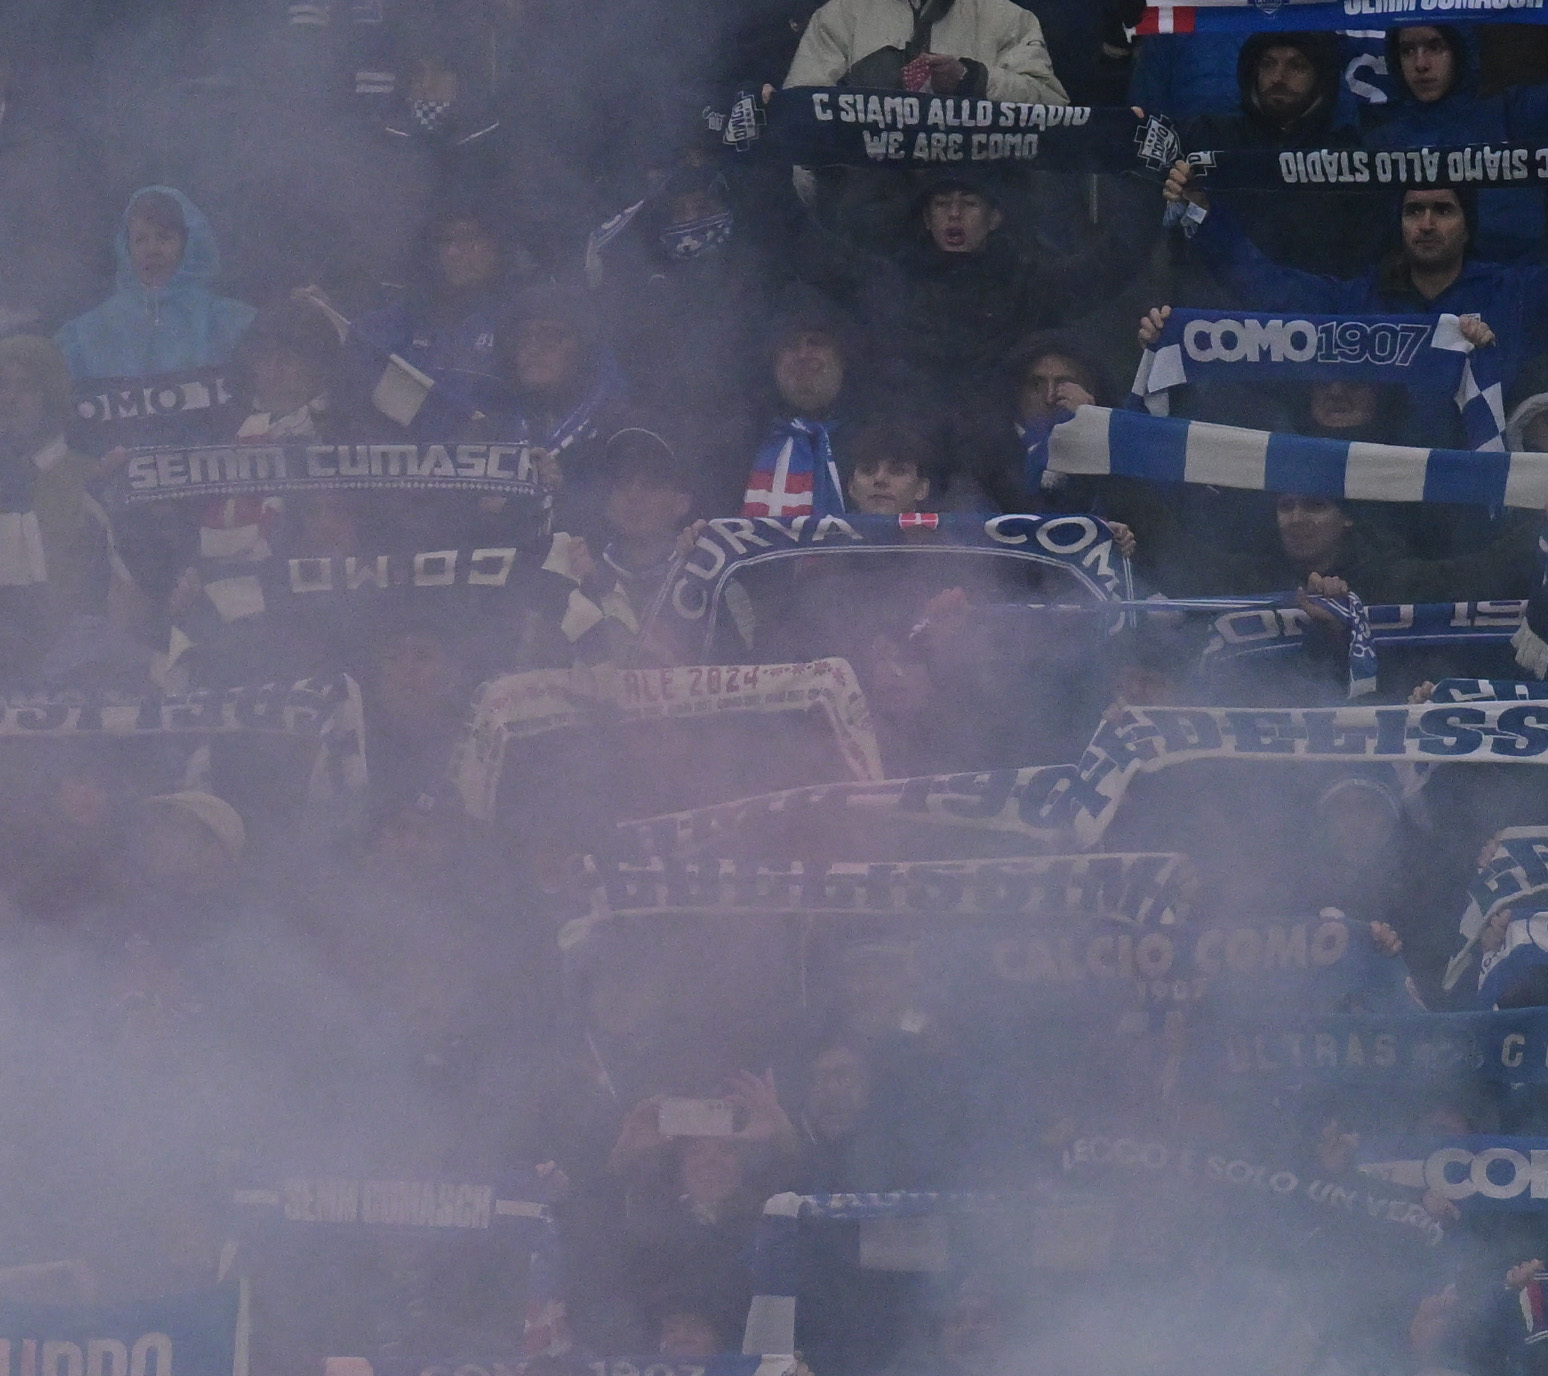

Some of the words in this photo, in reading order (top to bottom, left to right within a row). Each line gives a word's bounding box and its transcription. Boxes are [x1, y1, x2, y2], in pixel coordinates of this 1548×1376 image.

[838, 94, 920, 129] SIAMO
[927, 97, 995, 129] ALLO
[862, 130, 905, 160] WE
[912, 131, 964, 162] ARE
[971, 132, 1039, 161] COMO
[129, 443, 286, 489] SEMM
[1196, 920, 1349, 975] COMO
